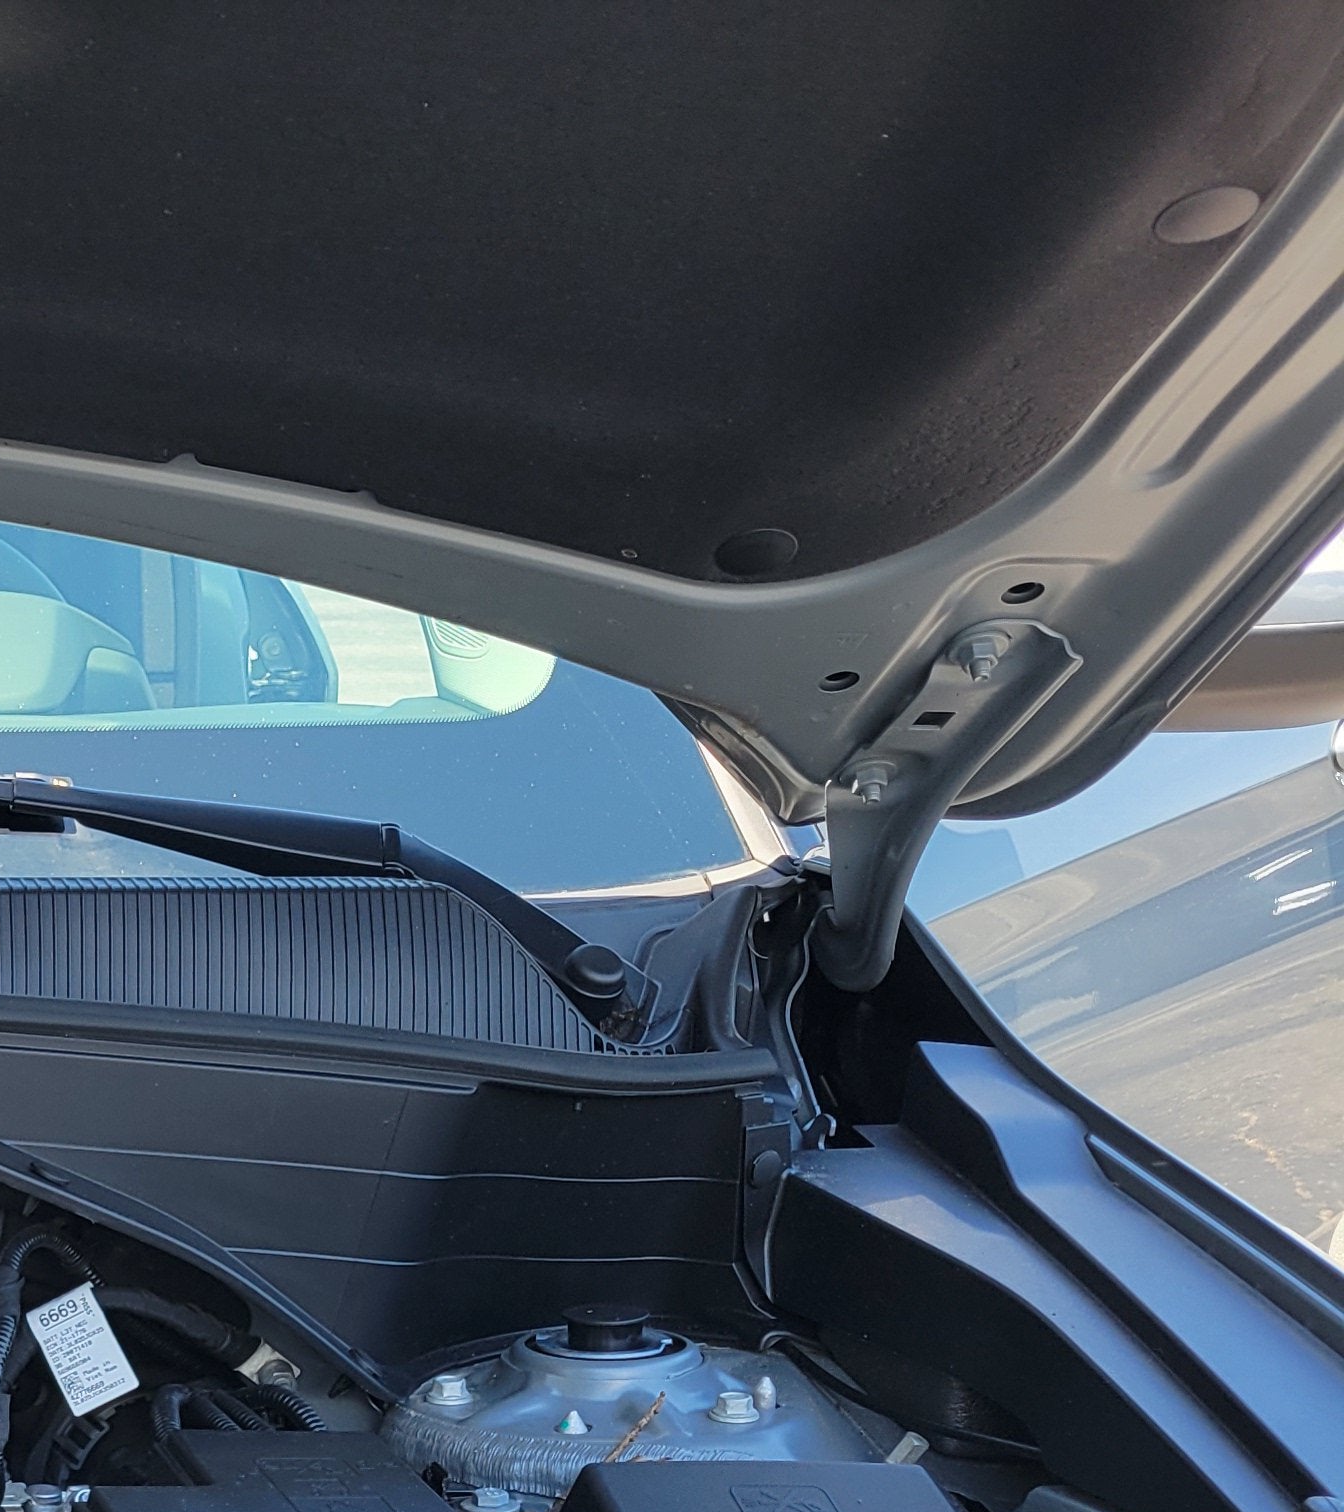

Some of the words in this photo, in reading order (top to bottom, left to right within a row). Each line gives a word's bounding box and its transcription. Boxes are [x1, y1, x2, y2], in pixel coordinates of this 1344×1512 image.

[38, 1299, 79, 1327] 6669
[83, 1365, 98, 1375] Made
[86, 1371, 101, 1382] Viet
